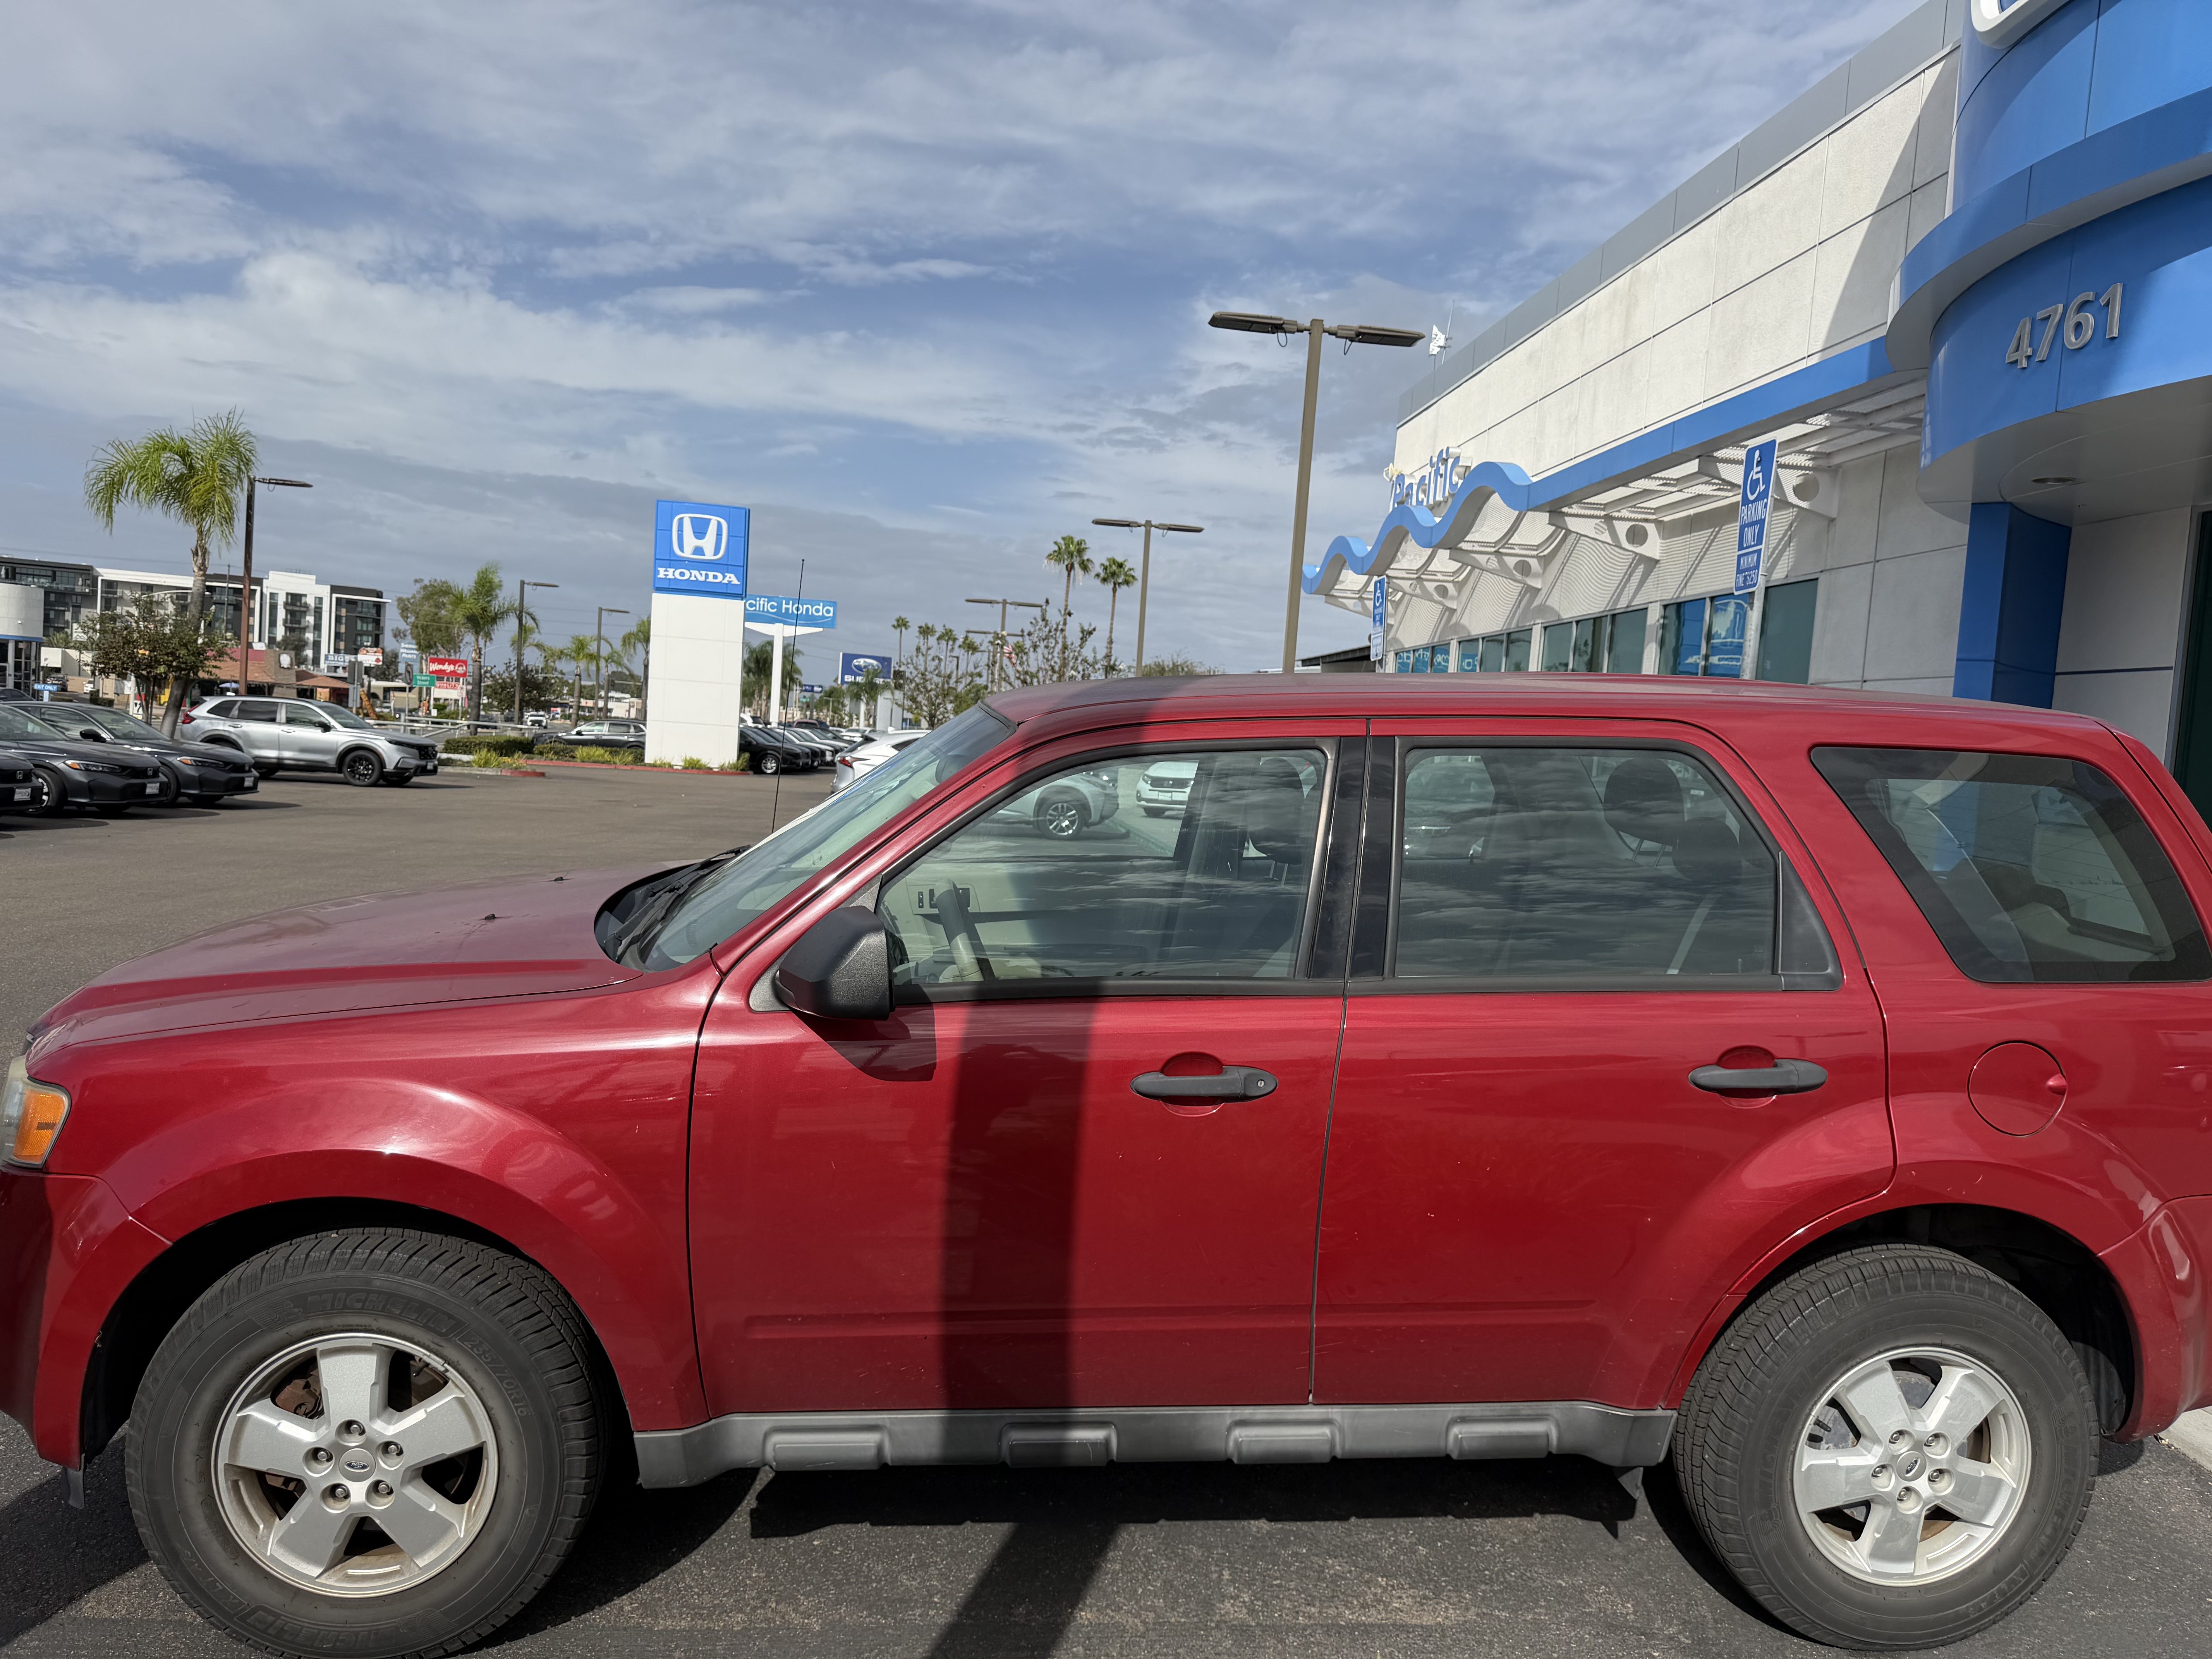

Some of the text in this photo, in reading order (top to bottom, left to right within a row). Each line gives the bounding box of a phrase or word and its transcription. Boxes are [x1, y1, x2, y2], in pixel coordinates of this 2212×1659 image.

[2006, 283, 2123, 368] 4761
[1393, 446, 1462, 505] Pacific
[1740, 498, 1767, 525] PARKING
[1743, 524, 1759, 547] ONLY
[1740, 553, 1757, 569] MINIMUM
[658, 567, 740, 585] HONDA
[1736, 573, 1744, 587] FINE
[746, 597, 833, 617] cific Honda
[429, 662, 455, 673] Wendy's
[307, 1292, 456, 1333] MICHELIN
[464, 1337, 529, 1417] 235/70R16
[247, 1611, 396, 1650] MICHELIN
